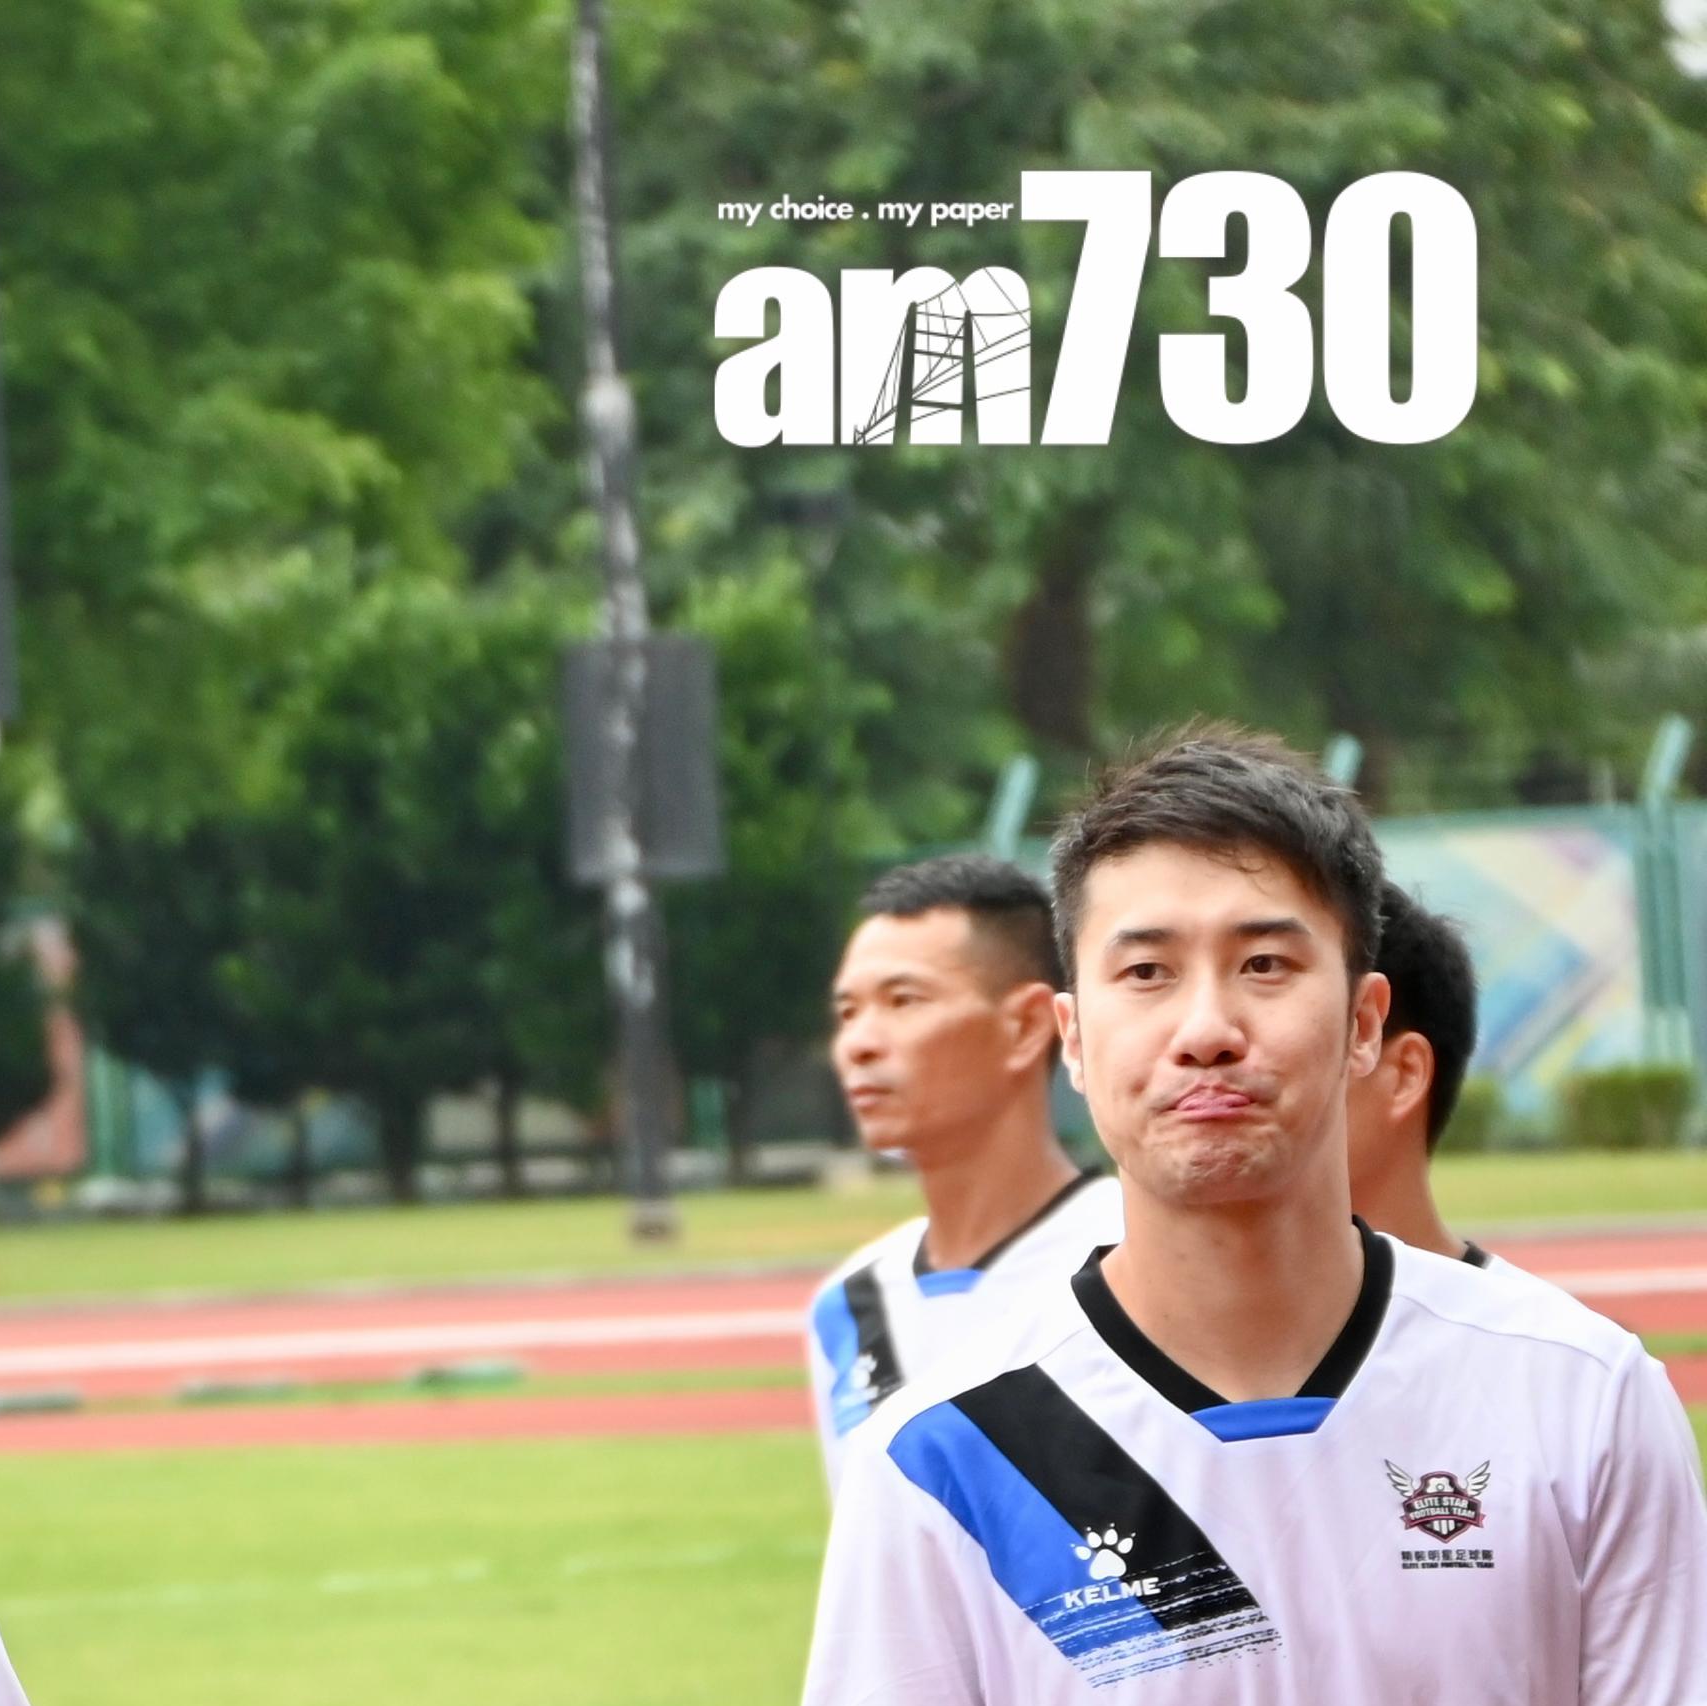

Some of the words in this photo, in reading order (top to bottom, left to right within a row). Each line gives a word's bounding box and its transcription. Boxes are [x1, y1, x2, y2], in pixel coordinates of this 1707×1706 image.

[1414, 1496, 1440, 1510] ELITE
[1442, 1496, 1468, 1508] STAR
[1409, 1507, 1450, 1520] FOOTBALL
[1452, 1507, 1475, 1519] TEAM
[1063, 1577, 1161, 1610] KELME
